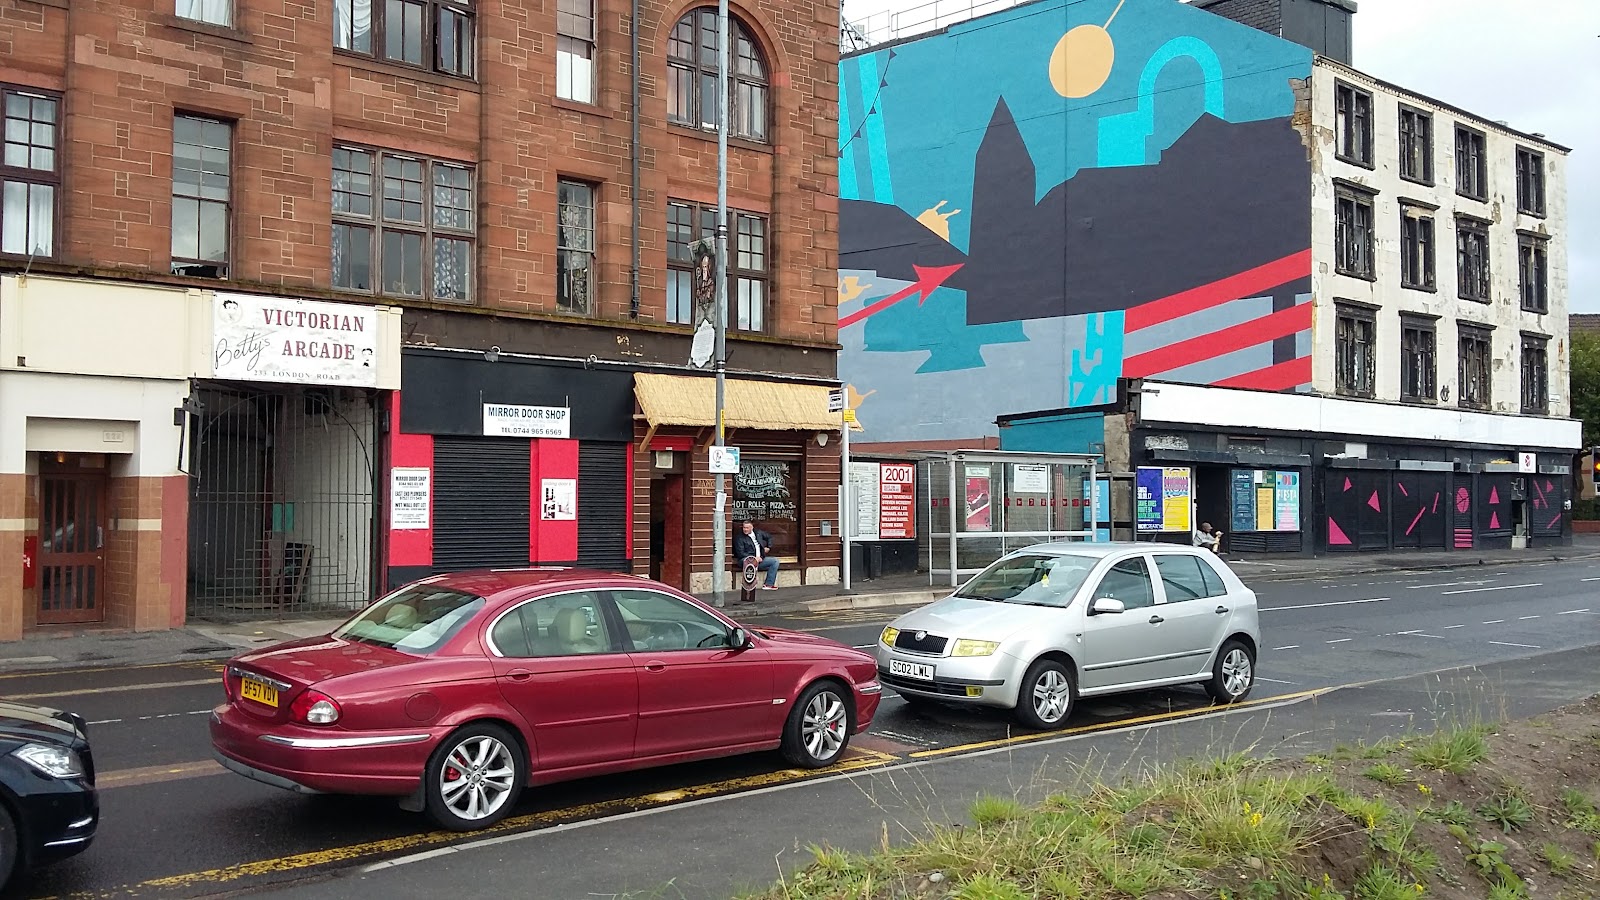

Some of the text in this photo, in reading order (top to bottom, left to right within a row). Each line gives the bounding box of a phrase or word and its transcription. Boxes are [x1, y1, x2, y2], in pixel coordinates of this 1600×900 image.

[263, 308, 365, 332] VICTORIAN
[215, 330, 277, 371] Betty's
[281, 340, 355, 360] ARCADE
[488, 406, 566, 420] MIRROR DOOR SHOP
[886, 468, 910, 482] 2001
[1278, 489, 1296, 501] FIESTA
[732, 500, 746, 508] HOT
[893, 661, 930, 678] SC02 LWL
[244, 680, 262, 698] BF57
